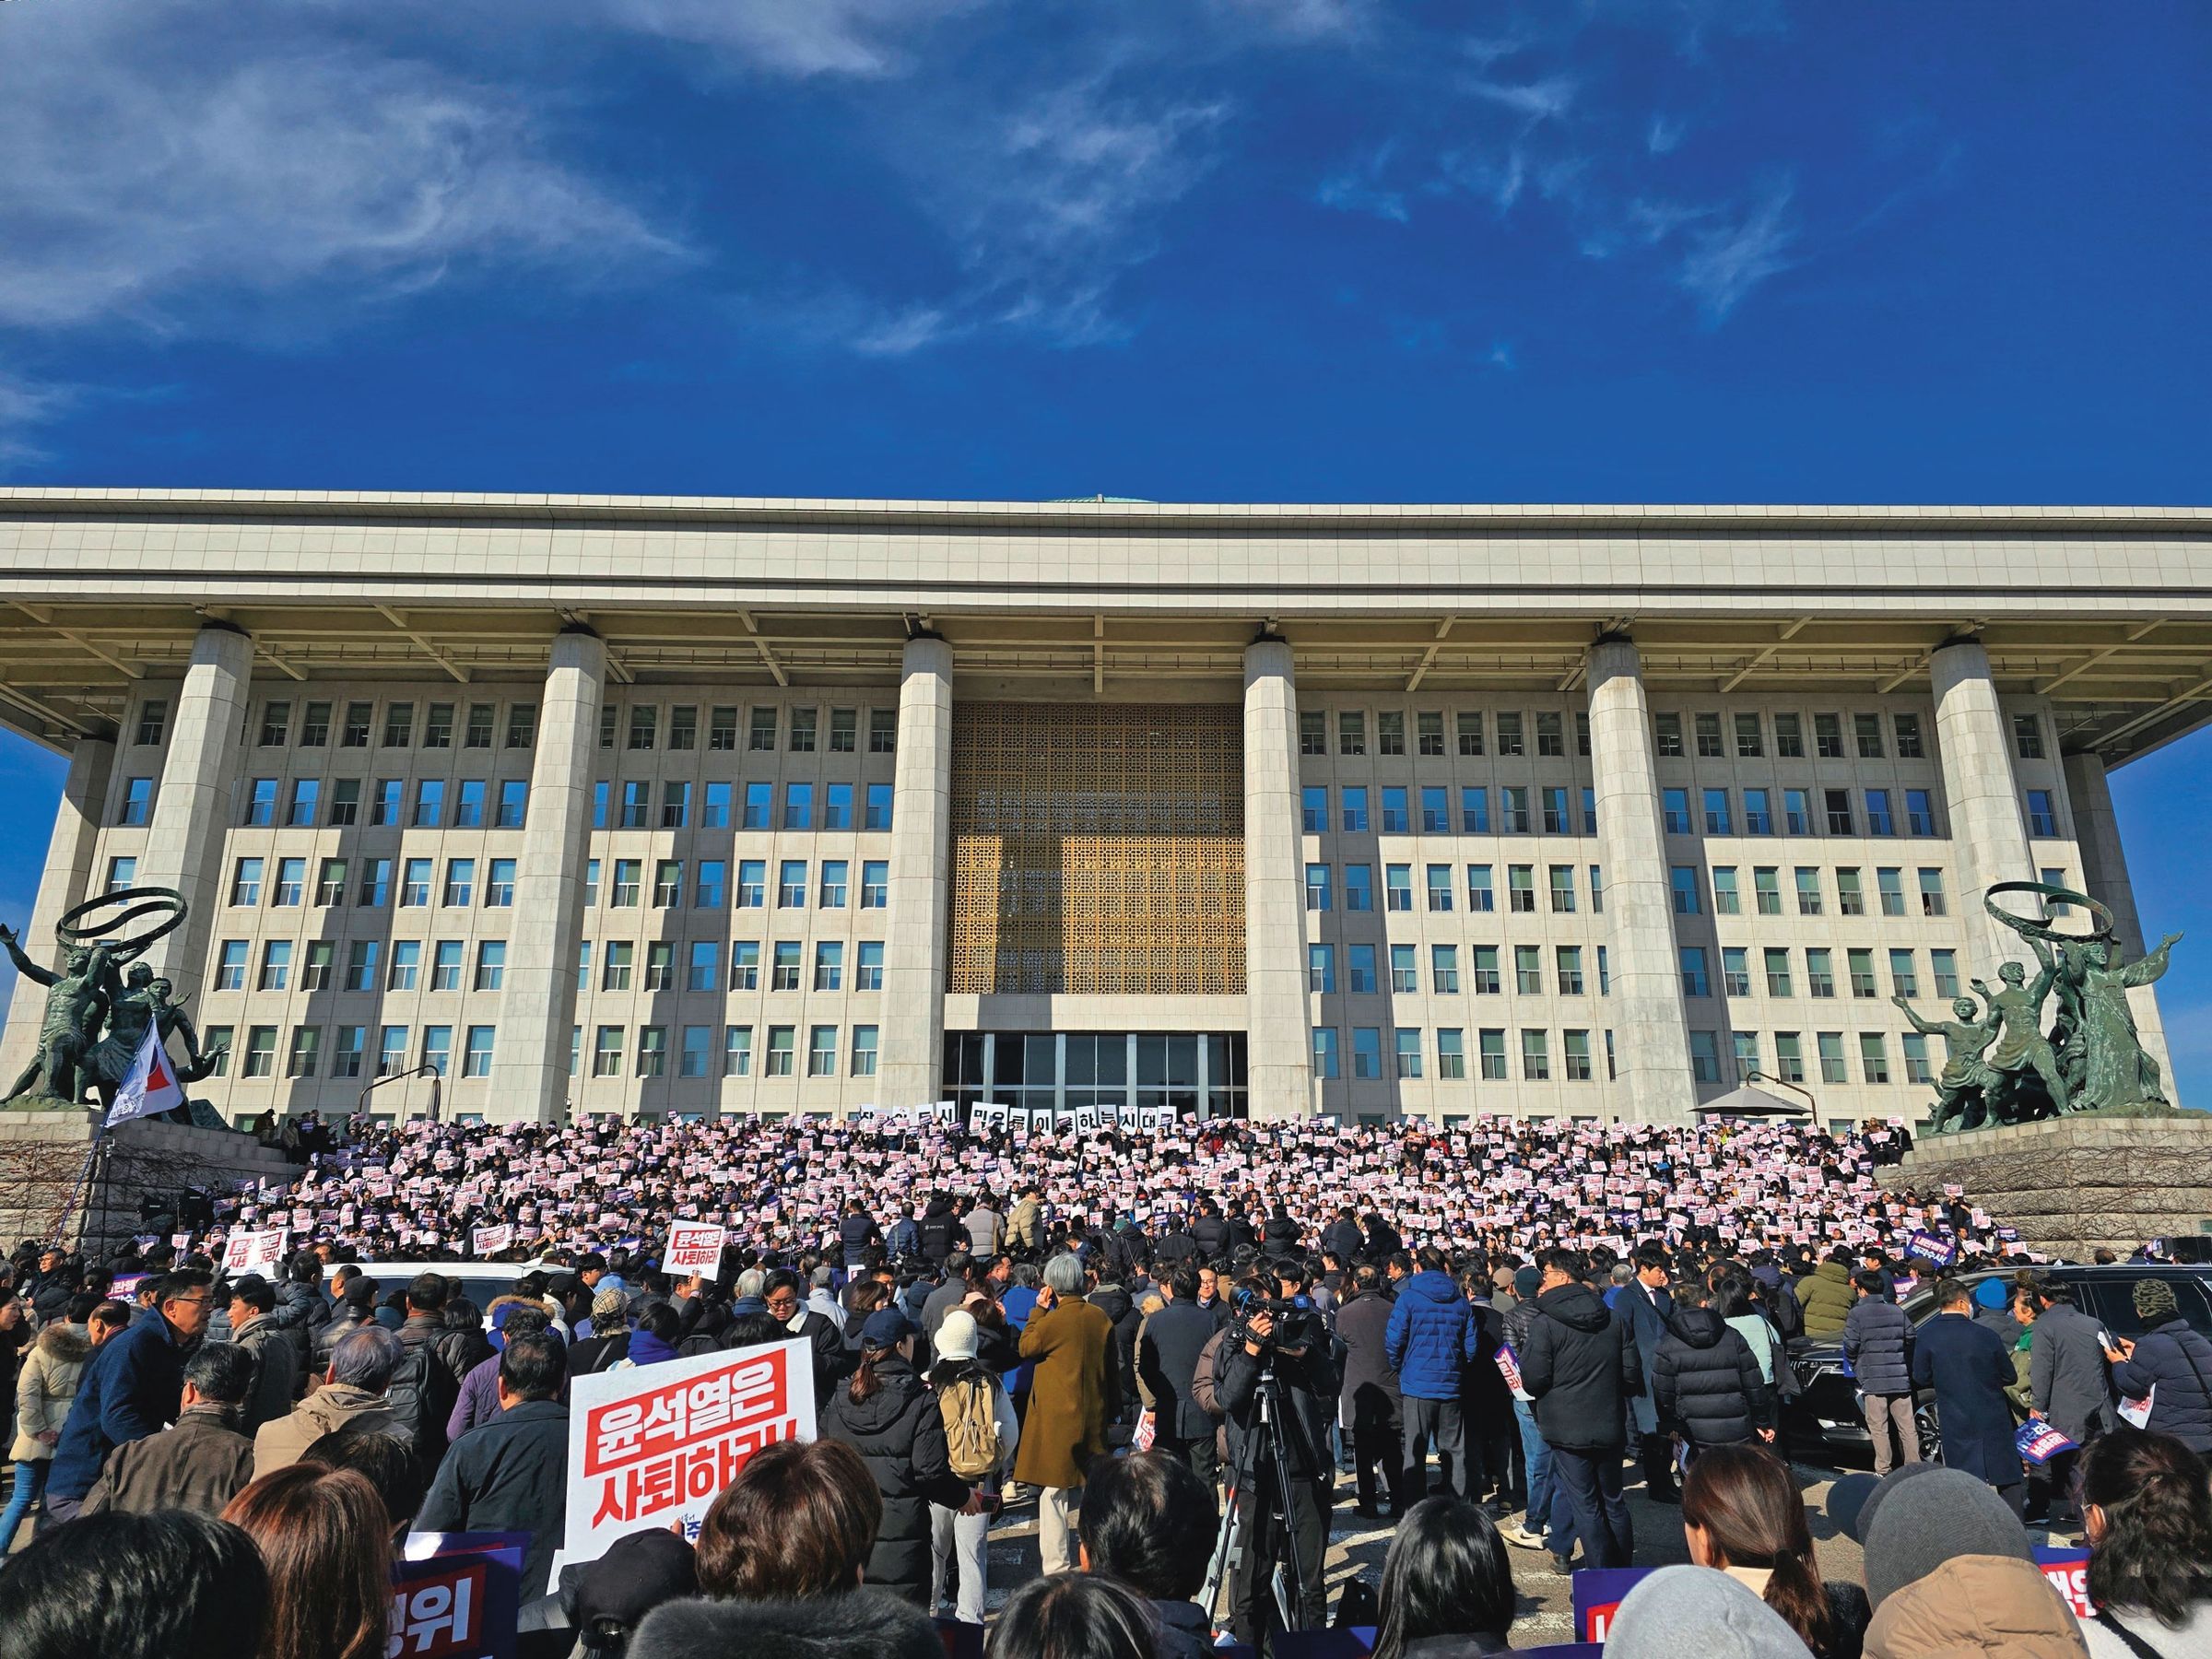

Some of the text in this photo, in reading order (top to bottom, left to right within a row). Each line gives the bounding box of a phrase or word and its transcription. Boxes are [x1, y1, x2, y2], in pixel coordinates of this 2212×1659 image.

[234, 1235, 278, 1253] 윤열은
[677, 1231, 721, 1247] 윤석열은
[672, 1250, 719, 1265] 사퇴하라!
[597, 1360, 776, 1465] 윤석열은
